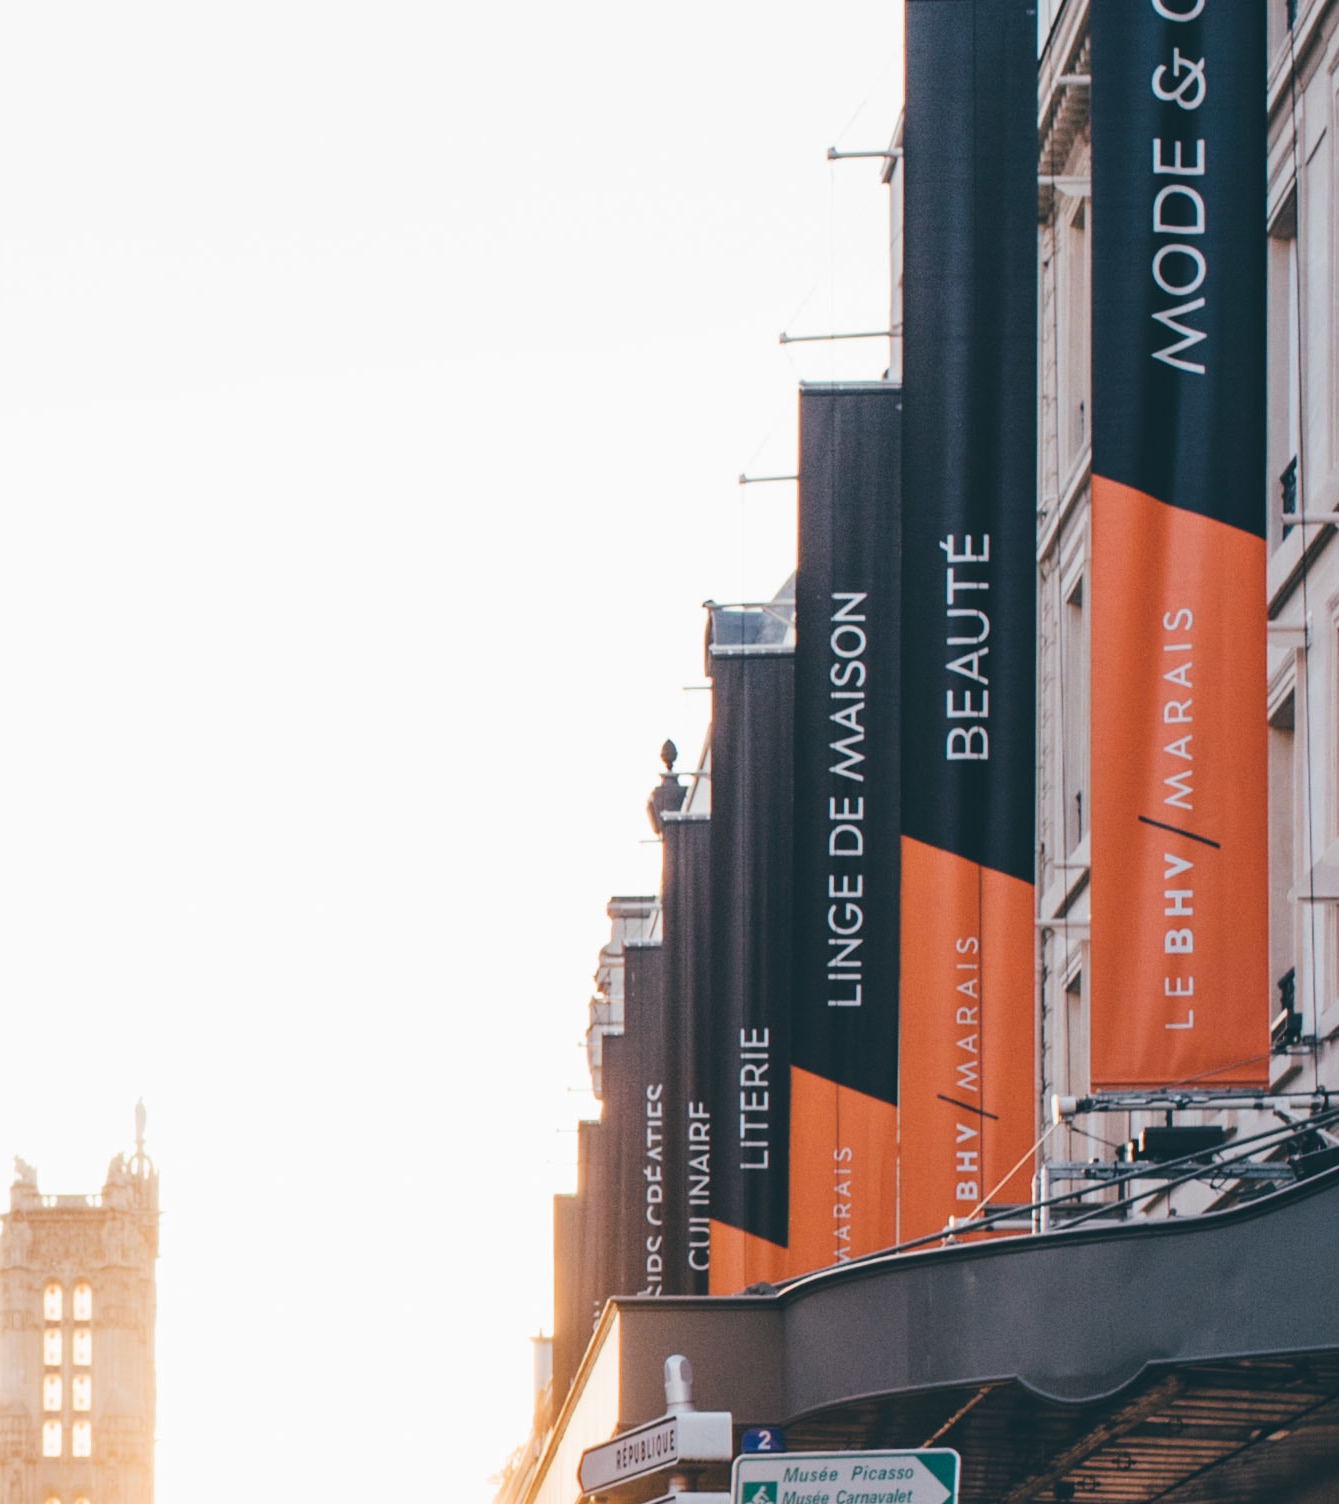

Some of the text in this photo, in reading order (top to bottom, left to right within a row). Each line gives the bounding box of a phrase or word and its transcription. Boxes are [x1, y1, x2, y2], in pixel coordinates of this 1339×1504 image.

[1151, 47, 1207, 110] &
[1150, 138, 1208, 375] MODE
[939, 533, 991, 761] BEAUTÉ
[1163, 607, 1194, 810] MARAIS
[827, 592, 868, 1007] LINGE DE MAISON
[1164, 853, 1195, 954] BHV
[955, 936, 980, 1091] MARAIS
[1164, 976, 1195, 1030] LE
[740, 1028, 770, 1169] LITERIE
[955, 1123, 979, 1200] BHV
[615, 1429, 676, 1471] RÉPUBLIQUE
[757, 1430, 772, 1451] 2
[783, 1464, 915, 1483] Musée Picasso
[836, 1488, 914, 1504] Carnavalet
